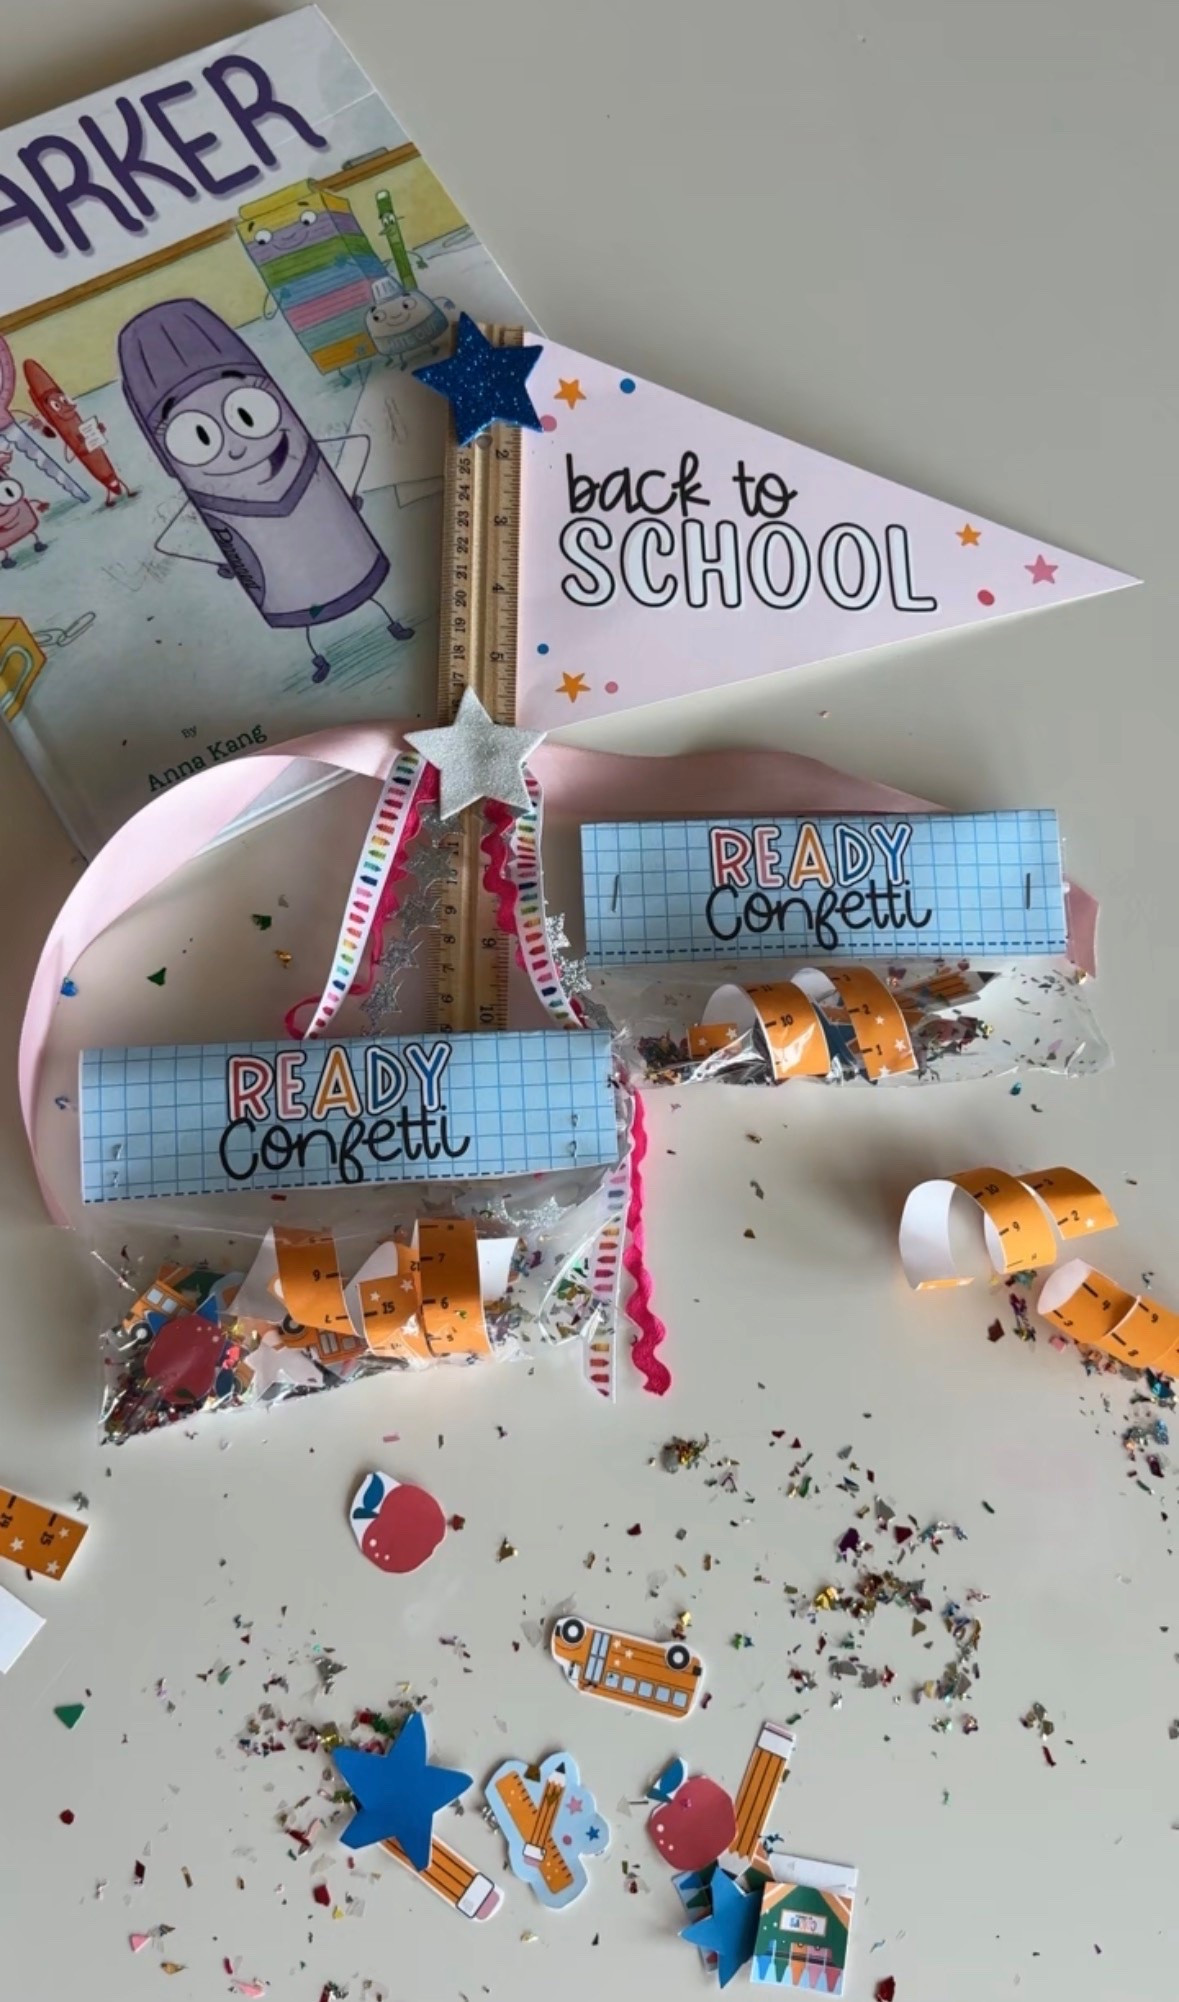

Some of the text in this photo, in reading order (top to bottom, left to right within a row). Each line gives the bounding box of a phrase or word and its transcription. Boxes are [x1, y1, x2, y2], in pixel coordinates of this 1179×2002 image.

[459, 458, 471, 474] 25
[566, 451, 798, 518] back to
[458, 485, 470, 501] 24
[457, 510, 469, 527] 23
[457, 537, 468, 553] 22
[490, 449, 509, 661] 2 3 4 5
[559, 516, 938, 612] SCHOOL
[456, 565, 467, 580] 21
[455, 590, 467, 607] 20
[454, 617, 466, 633] 19
[453, 645, 465, 660] 18
[453, 672, 464, 687] 17
[148, 724, 268, 792] Anna Kang
[708, 822, 913, 889] READY
[445, 905, 457, 915] 9
[705, 879, 932, 951] Confetti
[444, 936, 456, 944] 8
[480, 1005, 494, 1023] 10
[862, 1004, 871, 1015] 2
[780, 1014, 794, 1028] 10
[876, 1044, 883, 1055] 1
[225, 1040, 452, 1122] READY
[218, 1103, 471, 1183] Confetti
[984, 1184, 1000, 1196] 10
[1070, 1210, 1080, 1221] 2
[1012, 1221, 1021, 1232] 9
[437, 1252, 446, 1263] 7
[382, 1301, 395, 1315] 15
[440, 1296, 449, 1310] 6
[40, 1531, 54, 1546] 15
